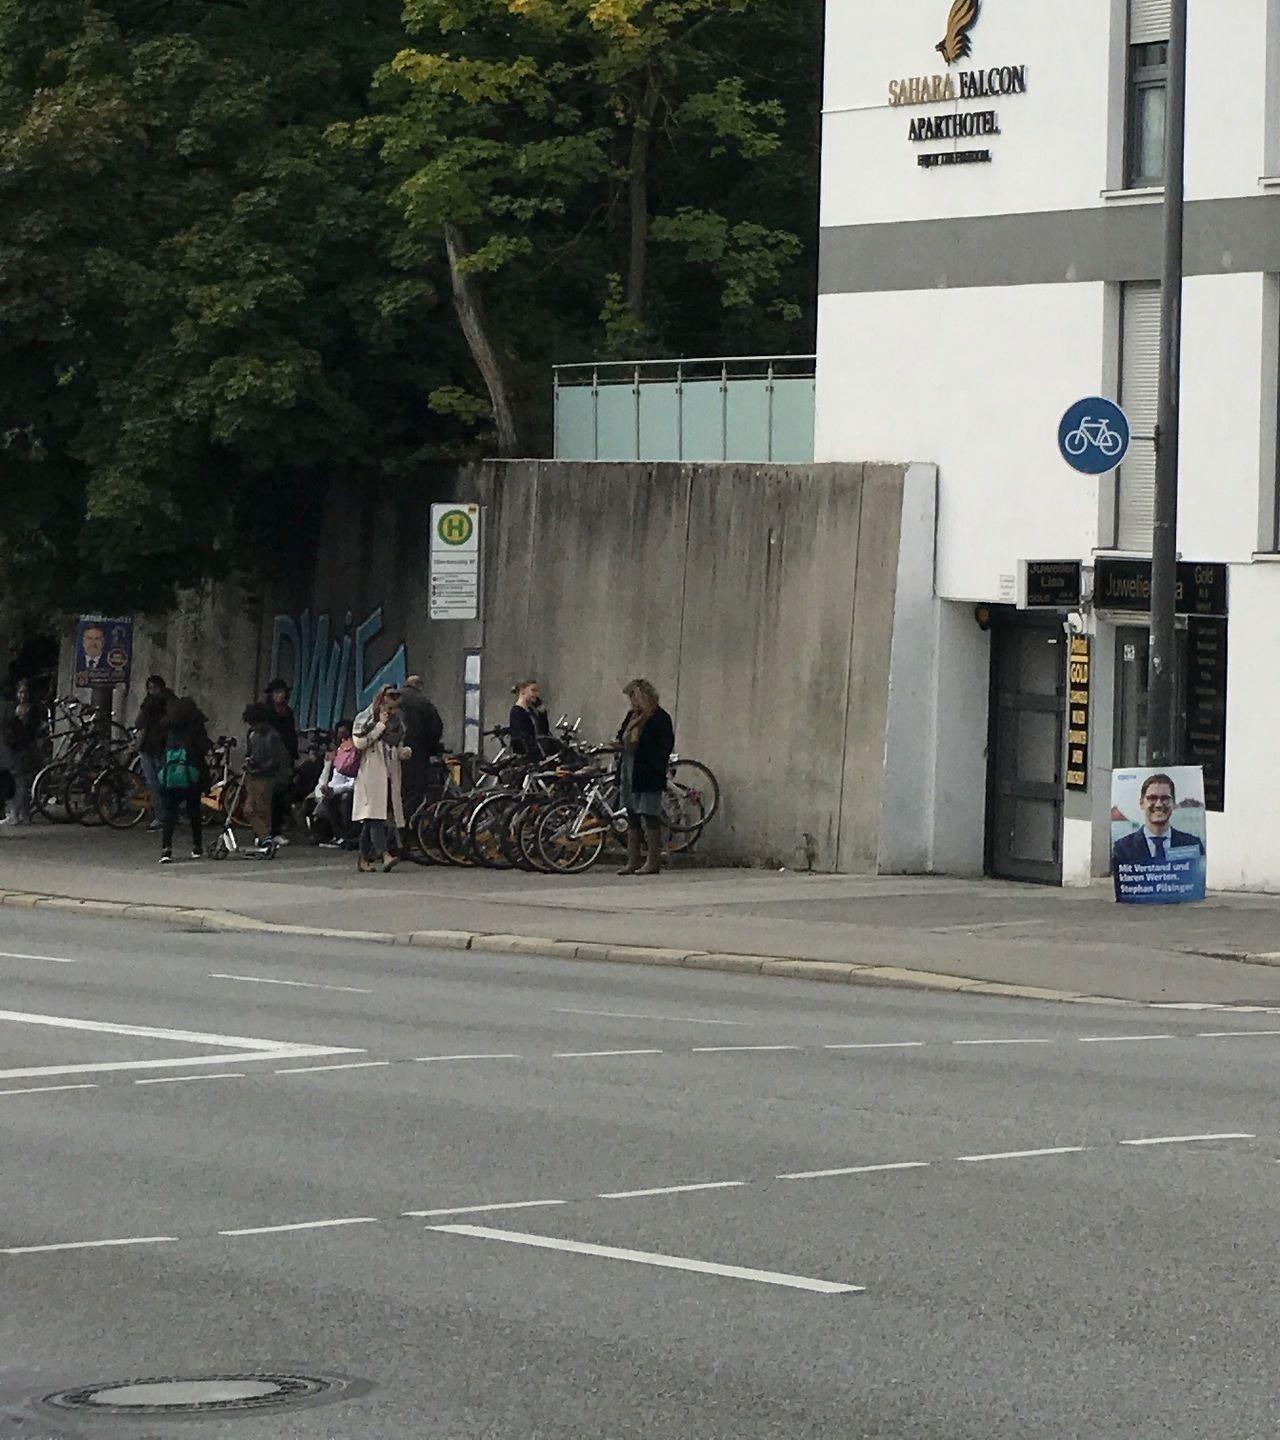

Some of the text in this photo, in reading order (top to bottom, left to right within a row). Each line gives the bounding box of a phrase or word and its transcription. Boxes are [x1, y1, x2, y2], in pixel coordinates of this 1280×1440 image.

[888, 64, 1026, 108] SAHARA FALCON
[907, 110, 1001, 142] APARTHOTEL
[447, 518, 465, 538] H
[1106, 572, 1153, 598] Juwelie
[1118, 862, 1190, 872] Mit Verstand und
[1120, 884, 1154, 895] Stephan
